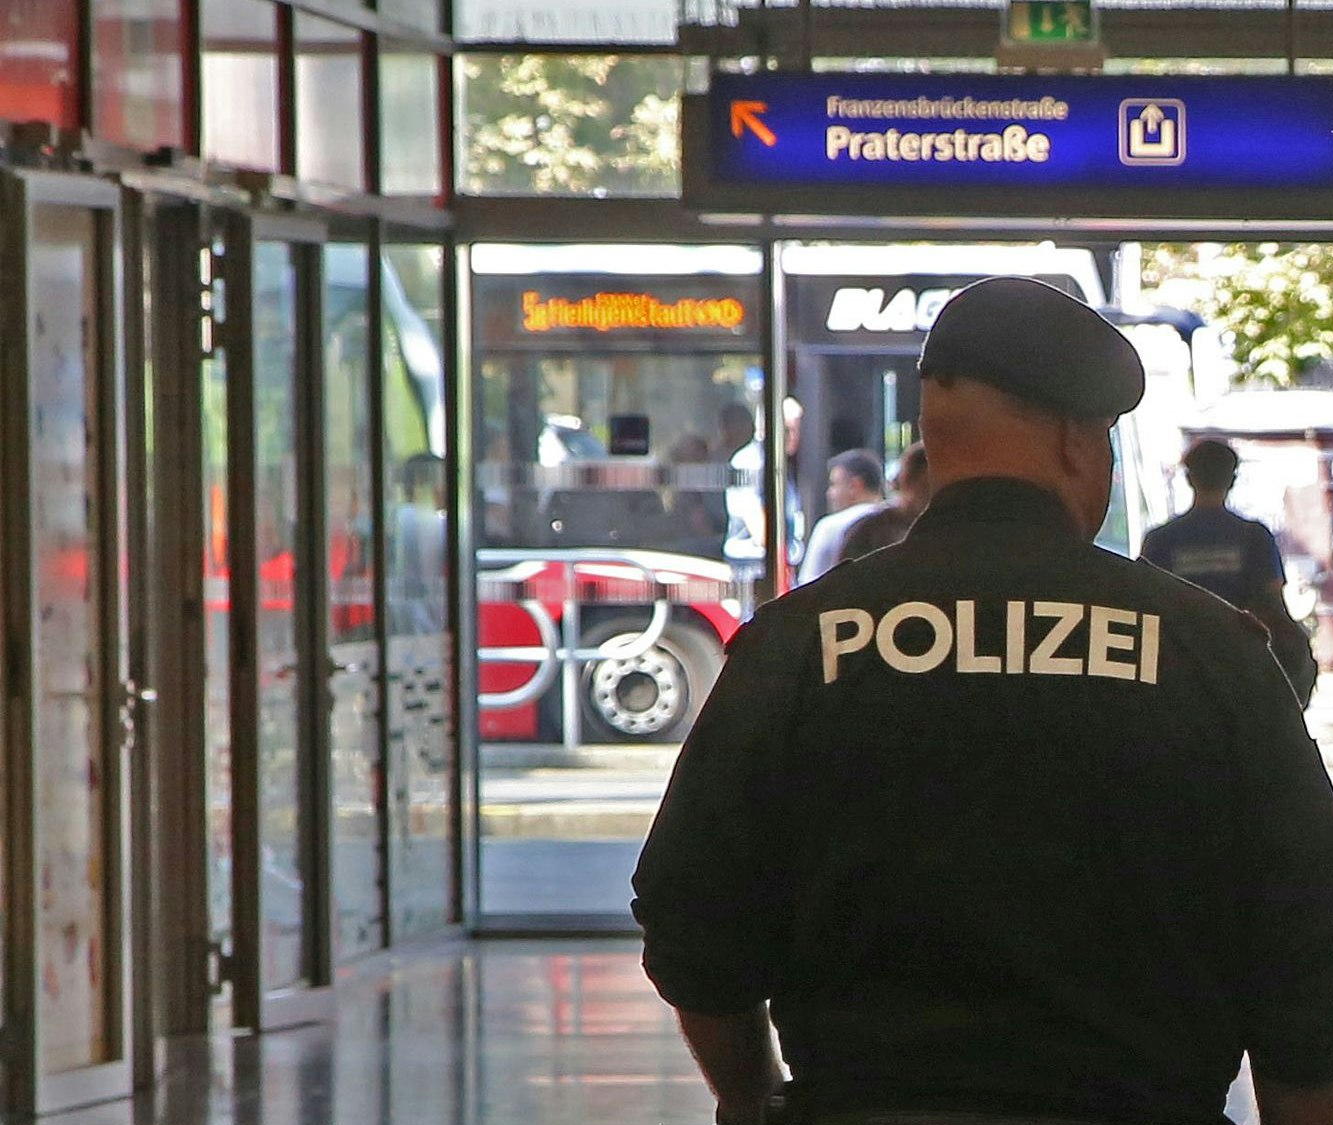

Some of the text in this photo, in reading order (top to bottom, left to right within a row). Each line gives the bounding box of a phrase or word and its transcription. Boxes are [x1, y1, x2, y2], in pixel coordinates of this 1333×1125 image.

[826, 95, 1069, 120] Franzensbrückenstraße
[826, 124, 1051, 162] Praterstraße
[826, 287, 962, 332] BLAG
[818, 599, 1160, 685] POLIZEI
